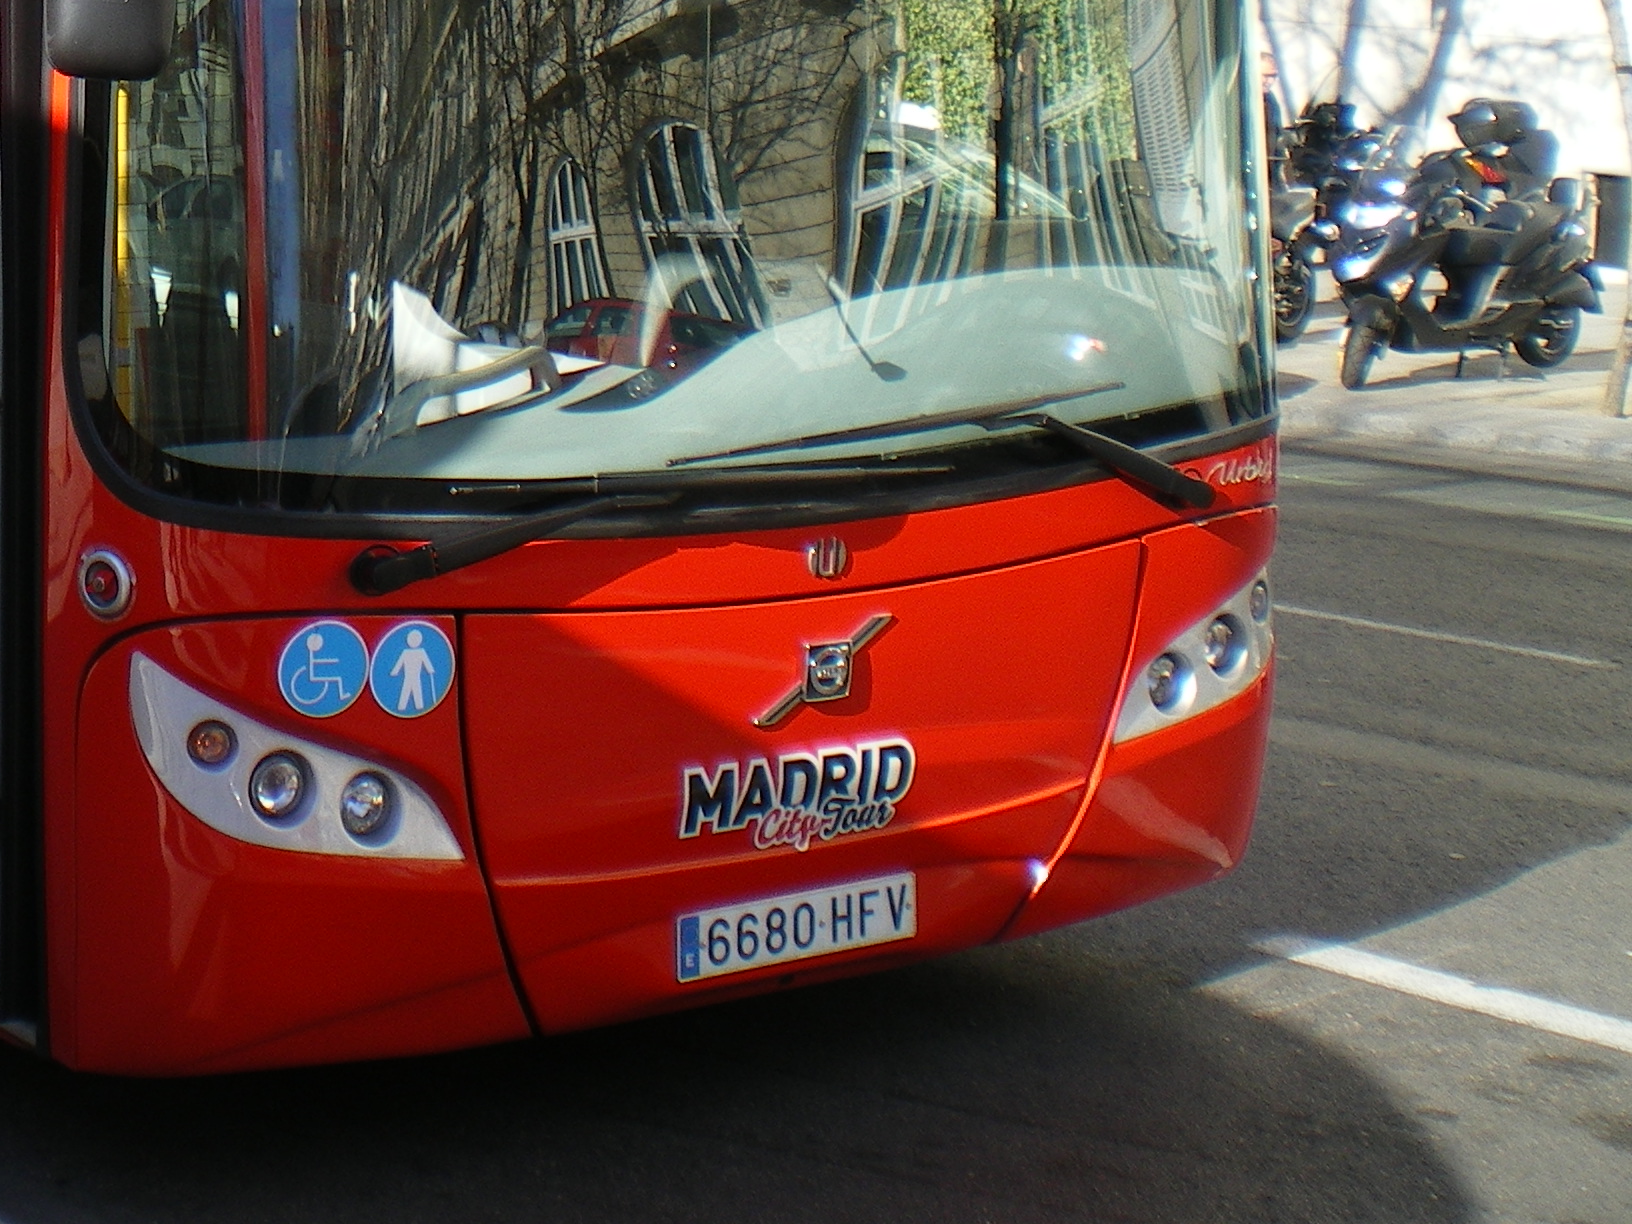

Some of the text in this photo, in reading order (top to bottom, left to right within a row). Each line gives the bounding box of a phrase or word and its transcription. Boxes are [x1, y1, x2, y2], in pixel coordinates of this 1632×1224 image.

[680, 739, 915, 838] MADRID
[754, 797, 896, 852] City Tour
[707, 883, 907, 967] 6680 HFV
